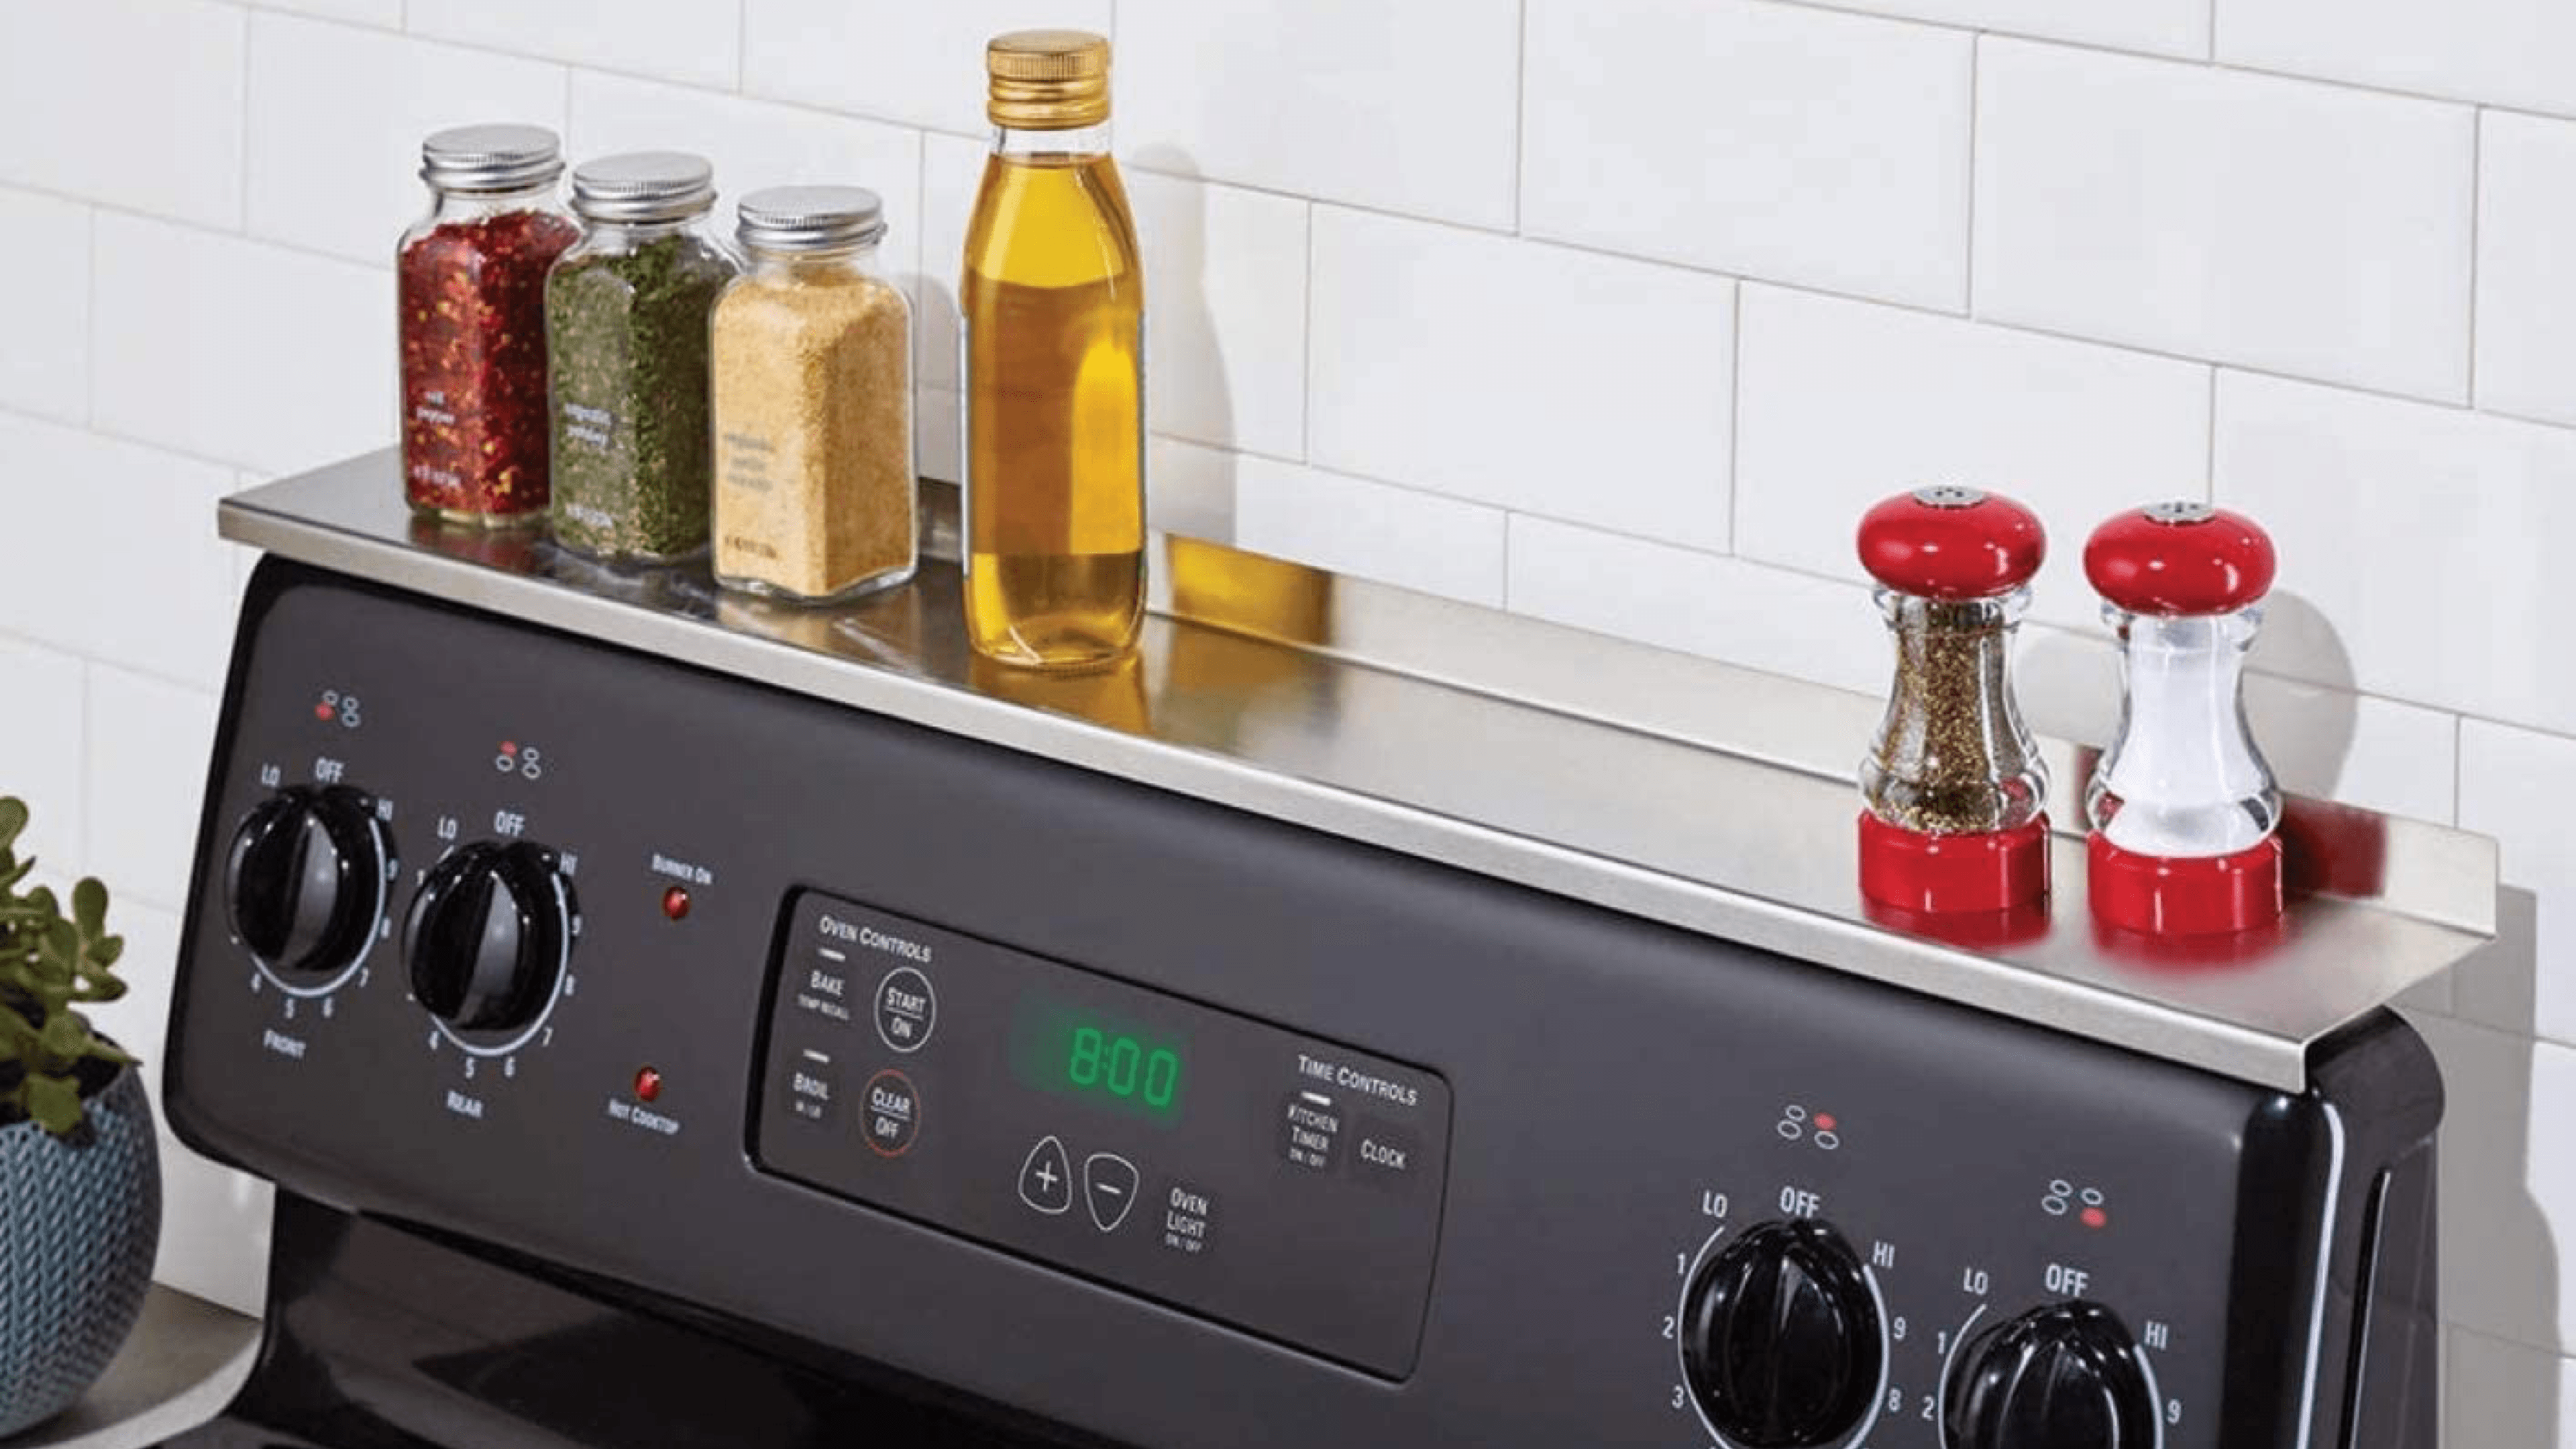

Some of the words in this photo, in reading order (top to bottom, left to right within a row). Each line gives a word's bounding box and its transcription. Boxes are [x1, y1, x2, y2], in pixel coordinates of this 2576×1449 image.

[262, 763, 280, 787] LO
[315, 757, 344, 782] OFF
[437, 816, 458, 840] LO
[494, 810, 526, 837] OFF
[819, 915, 858, 942] OVEN
[859, 926, 932, 963] CONTROLS
[810, 970, 846, 996] BAKE
[886, 987, 926, 1013] START
[892, 1016, 912, 1039] ON
[1069, 1026, 1179, 1109] 8:00
[1298, 1053, 1335, 1081] TIME
[1337, 1066, 1418, 1107] CONTROLS
[872, 1086, 911, 1114] CLEAR
[1360, 1138, 1406, 1170] CLOCK
[1169, 1187, 1208, 1216] OVEN
[1702, 1189, 1729, 1218] LO
[1779, 1185, 1821, 1219] OFF
[1167, 1210, 1206, 1238] LIGHT
[1677, 1252, 1686, 1275] 1
[1872, 1239, 1896, 1269] HI
[1963, 1267, 1989, 1296] LO
[2045, 1263, 2089, 1297] OFF
[1661, 1315, 1674, 1340] 2
[1893, 1316, 1907, 1341] 9
[2145, 1319, 2169, 1350] HI
[1938, 1331, 1947, 1354] 1
[1671, 1385, 1685, 1409] 3
[1889, 1388, 1902, 1413] 8
[1921, 1395, 1935, 1421] 2
[2167, 1397, 2182, 1426] 9
